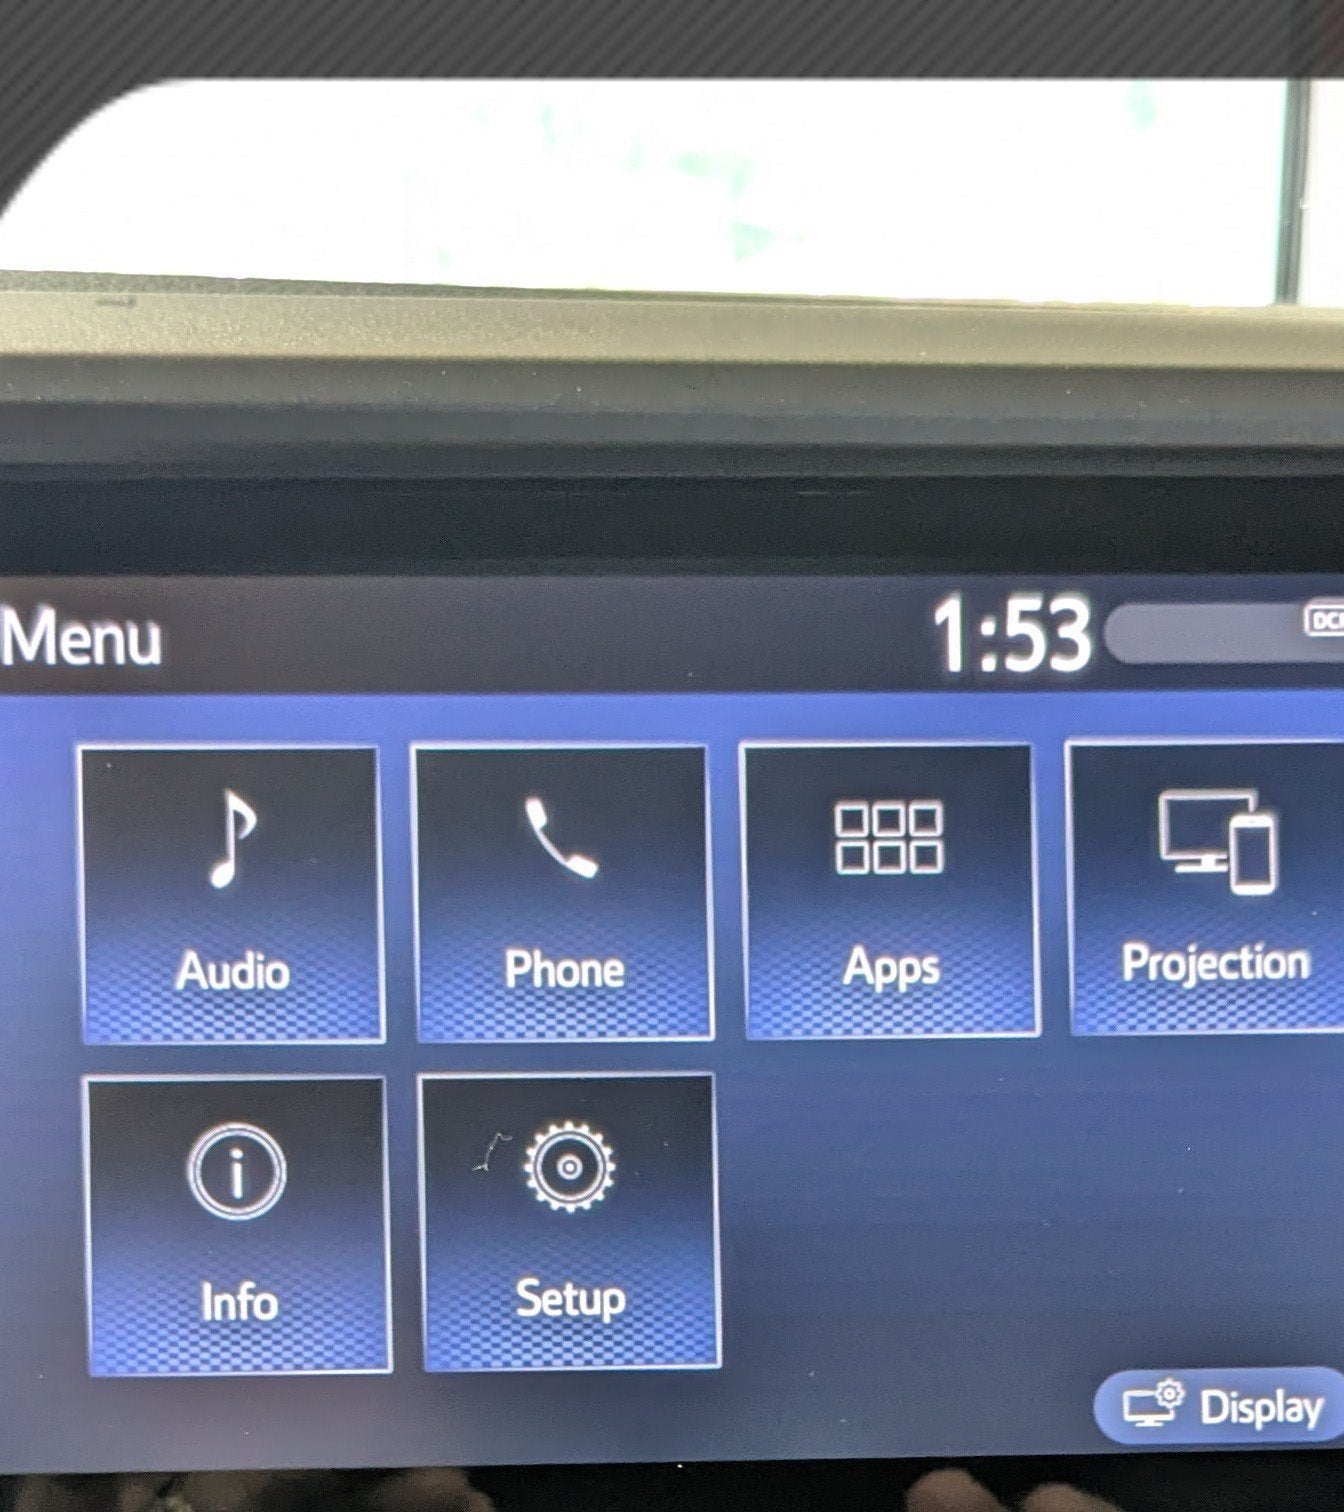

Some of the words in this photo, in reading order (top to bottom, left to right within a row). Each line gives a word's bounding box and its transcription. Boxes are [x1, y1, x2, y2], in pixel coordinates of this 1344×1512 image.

[934, 594, 1093, 674] 1:53
[174, 950, 291, 990] Audio
[504, 950, 626, 988] Phone
[843, 945, 941, 993] Apps
[1122, 943, 1310, 988] Projection
[201, 1282, 279, 1322] Info
[516, 1278, 626, 1324] Setup
[1201, 1389, 1325, 1430] Display
